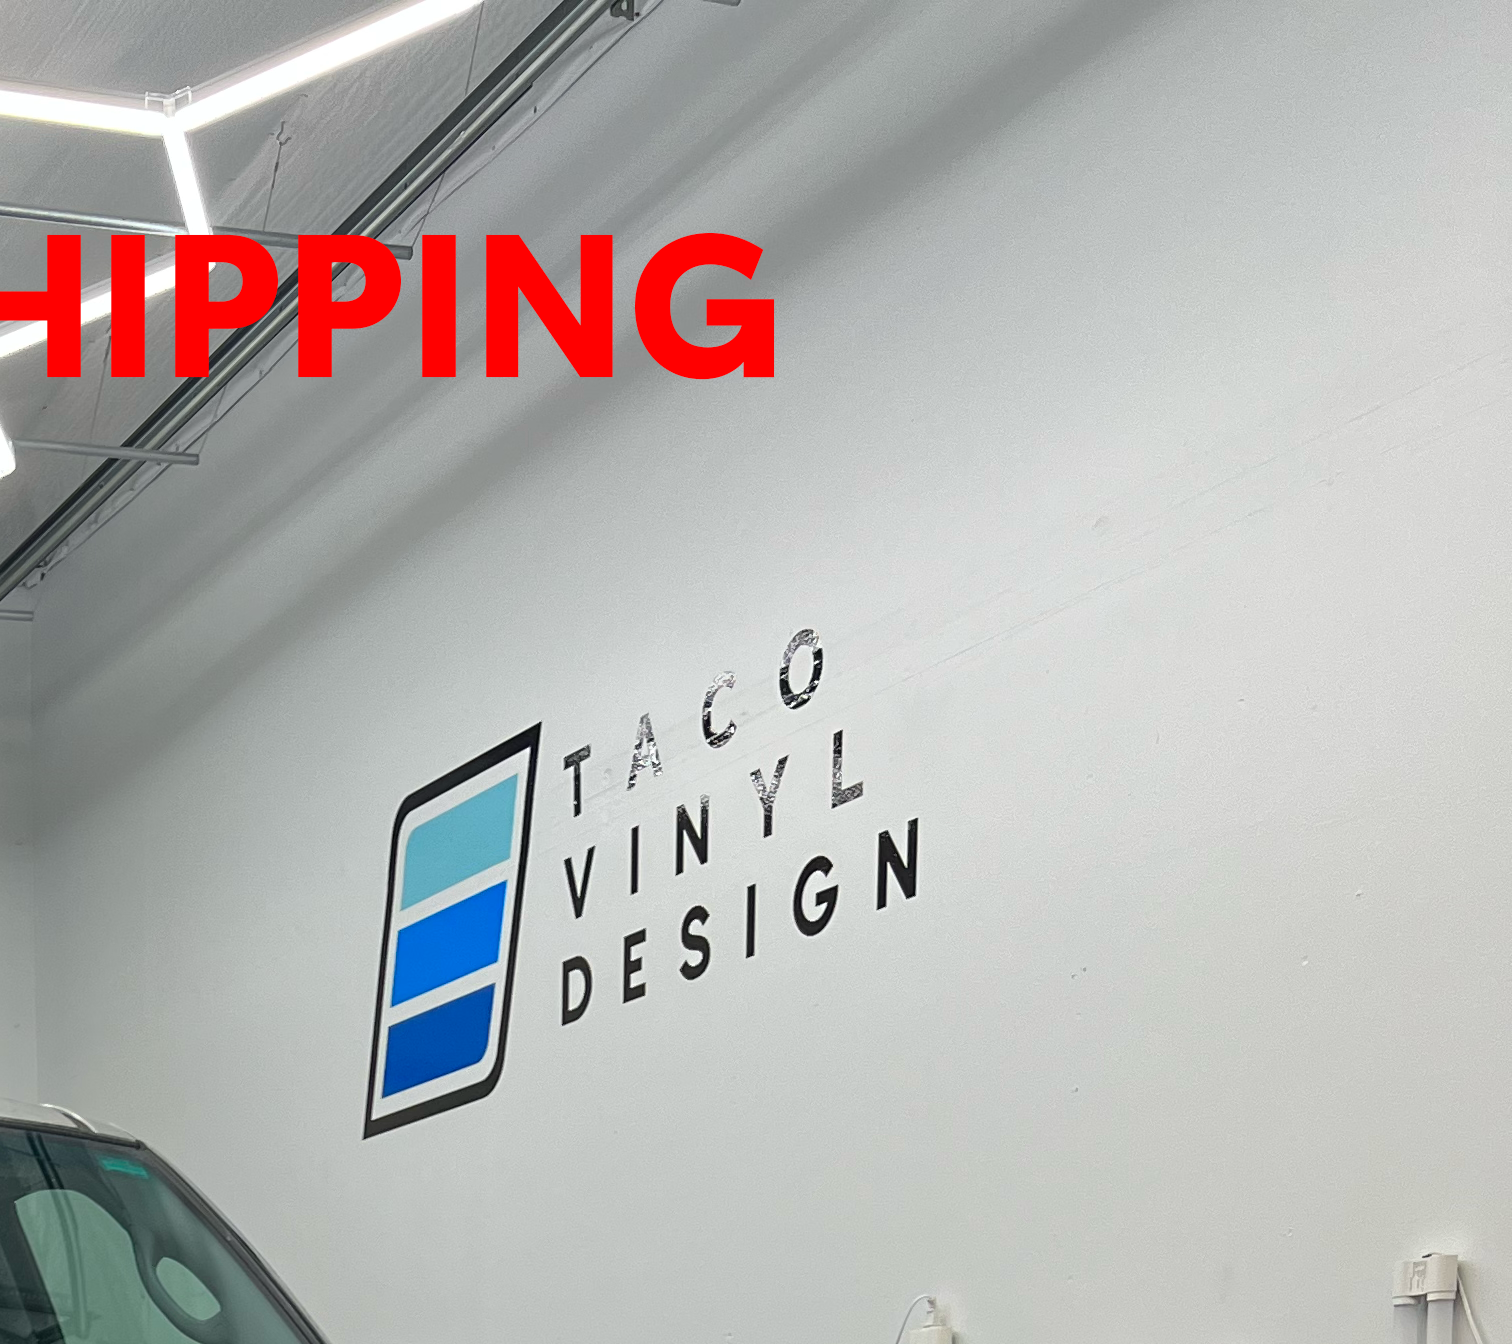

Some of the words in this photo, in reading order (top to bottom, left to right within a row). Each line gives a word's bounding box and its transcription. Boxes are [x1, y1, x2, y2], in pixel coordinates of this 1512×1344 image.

[563, 628, 824, 818] TACO
[564, 729, 864, 920] VINYL
[561, 817, 919, 1026] DESIGN
